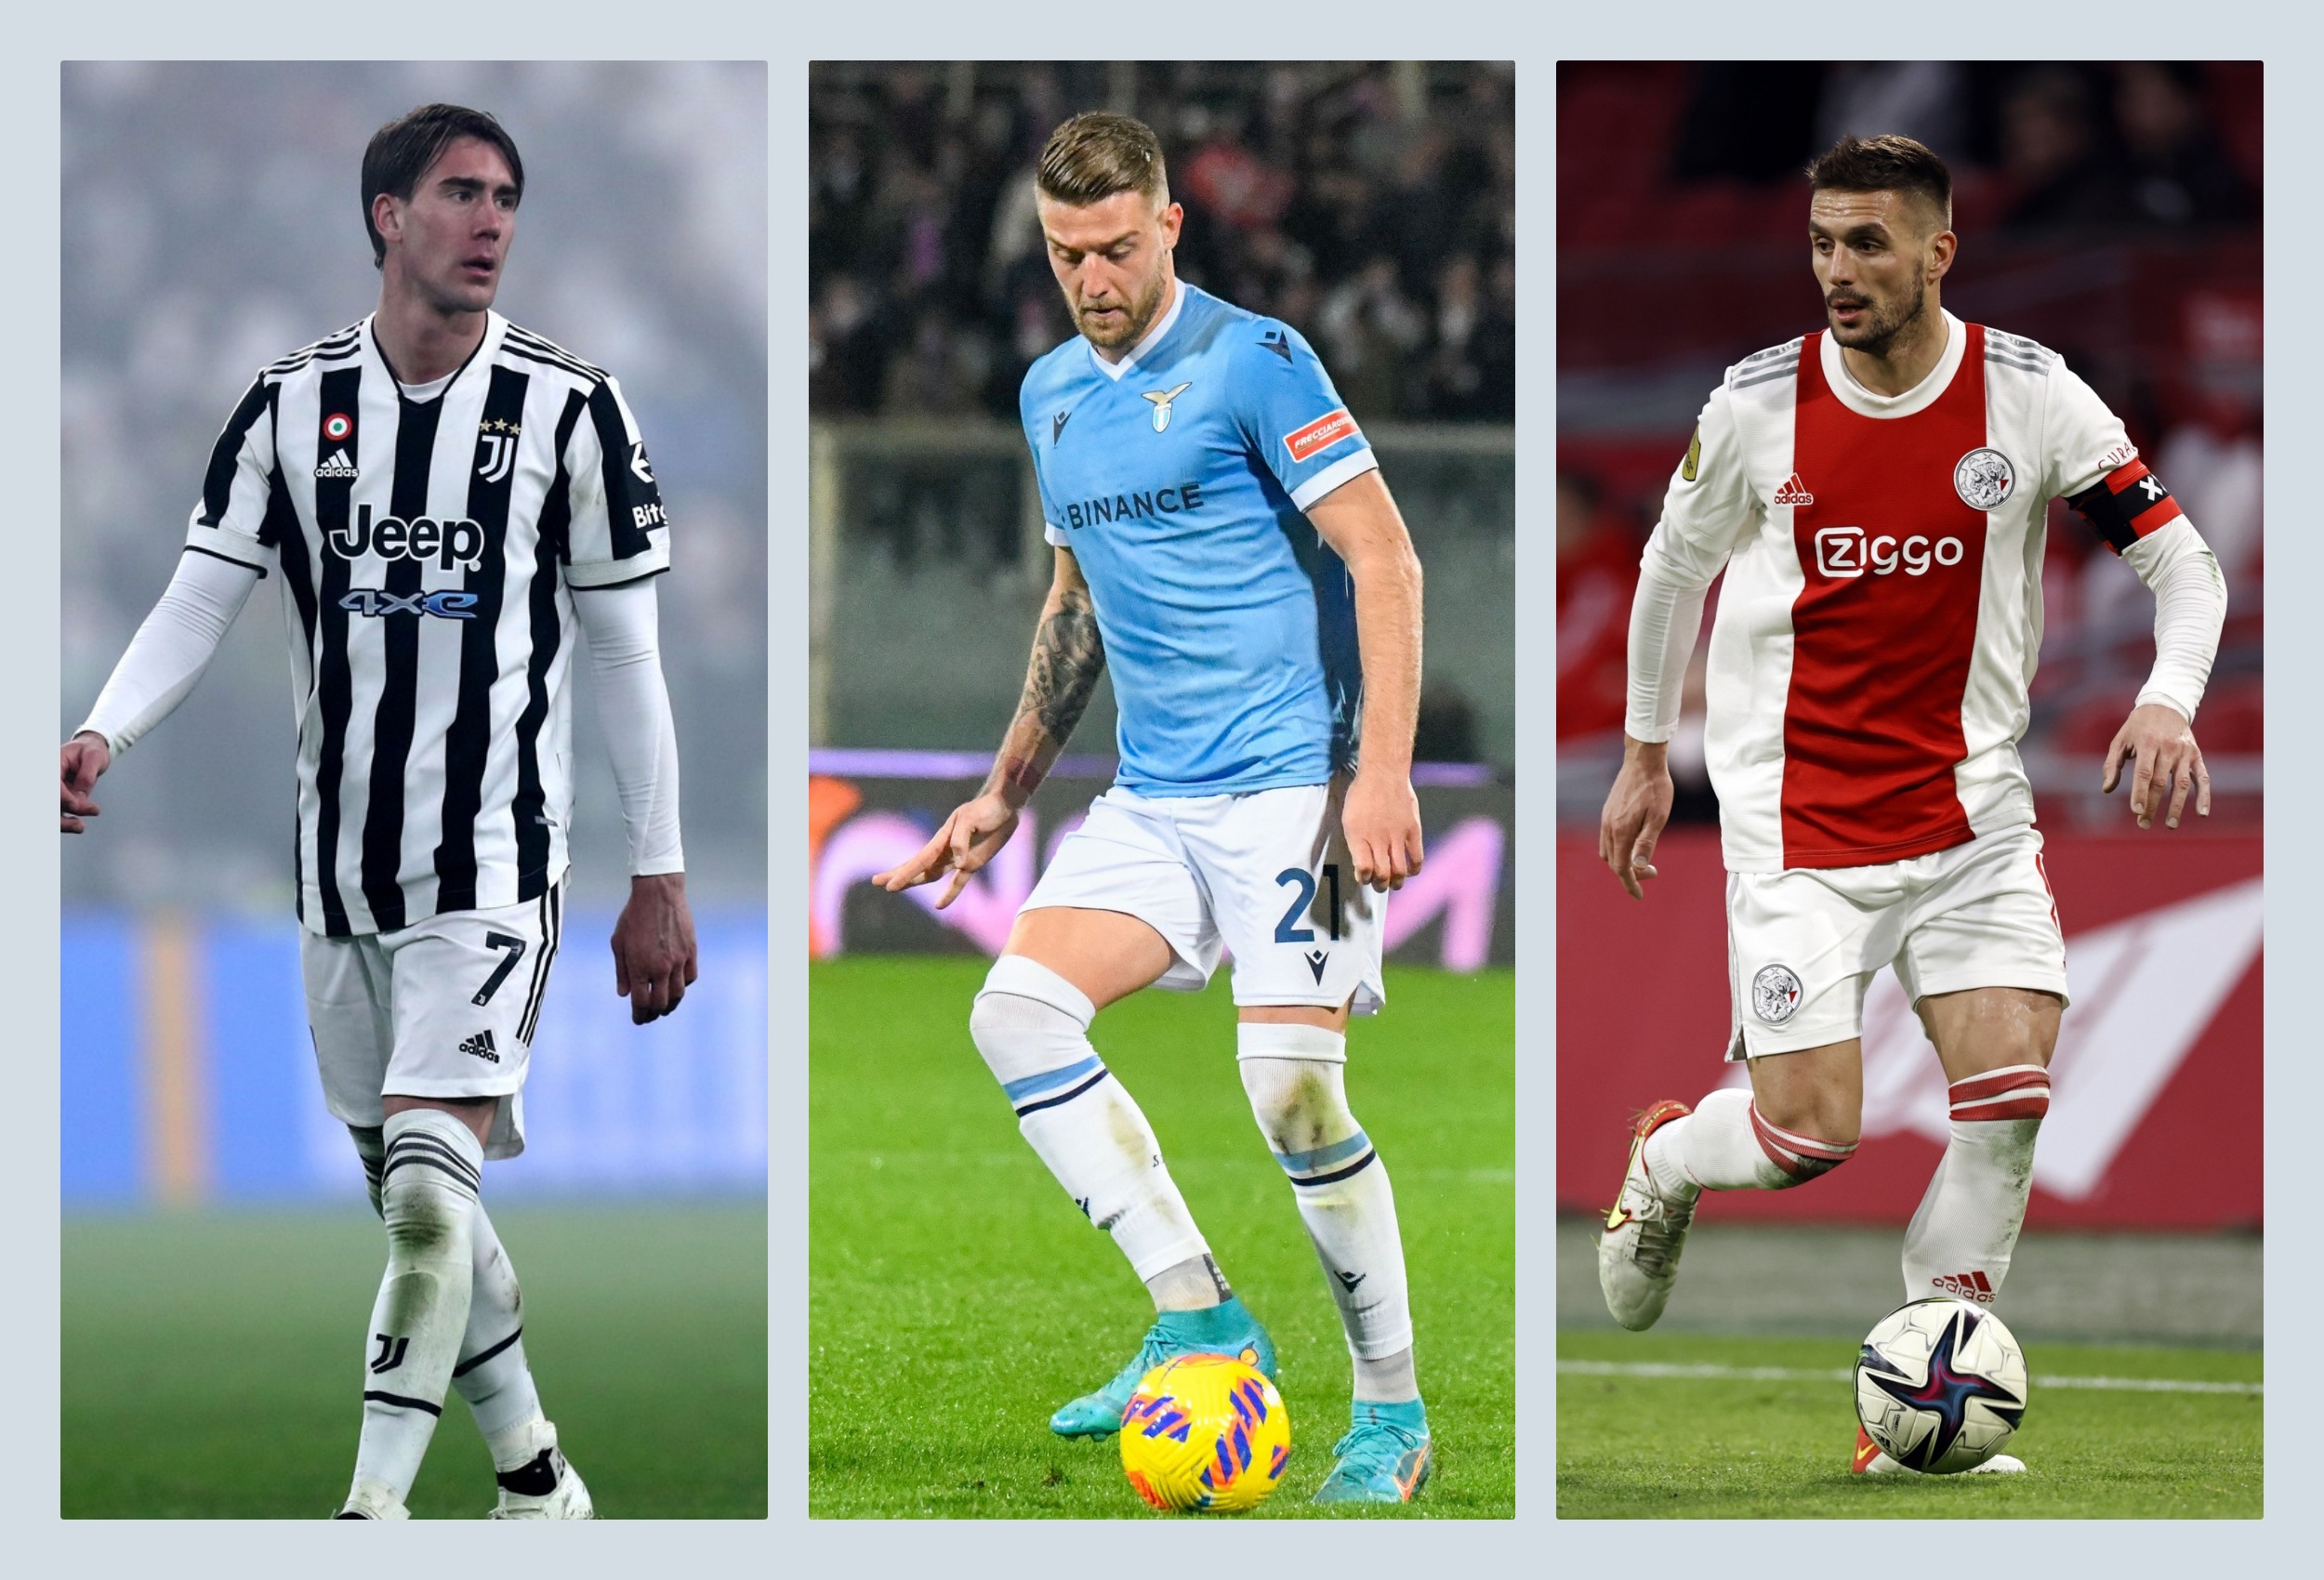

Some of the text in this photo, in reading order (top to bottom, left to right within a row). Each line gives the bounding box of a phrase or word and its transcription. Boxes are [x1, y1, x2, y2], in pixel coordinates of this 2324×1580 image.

[2098, 441, 2136, 470] CURA
[315, 467, 359, 478] adidas
[1067, 483, 1204, 530] BINANCE
[1774, 493, 1812, 505] adidas
[330, 503, 484, 573] Jeep
[1274, 864, 1340, 943] 21
[471, 930, 527, 1007] 7
[458, 1042, 500, 1064] adidas
[1932, 1277, 1996, 1303] adidas
